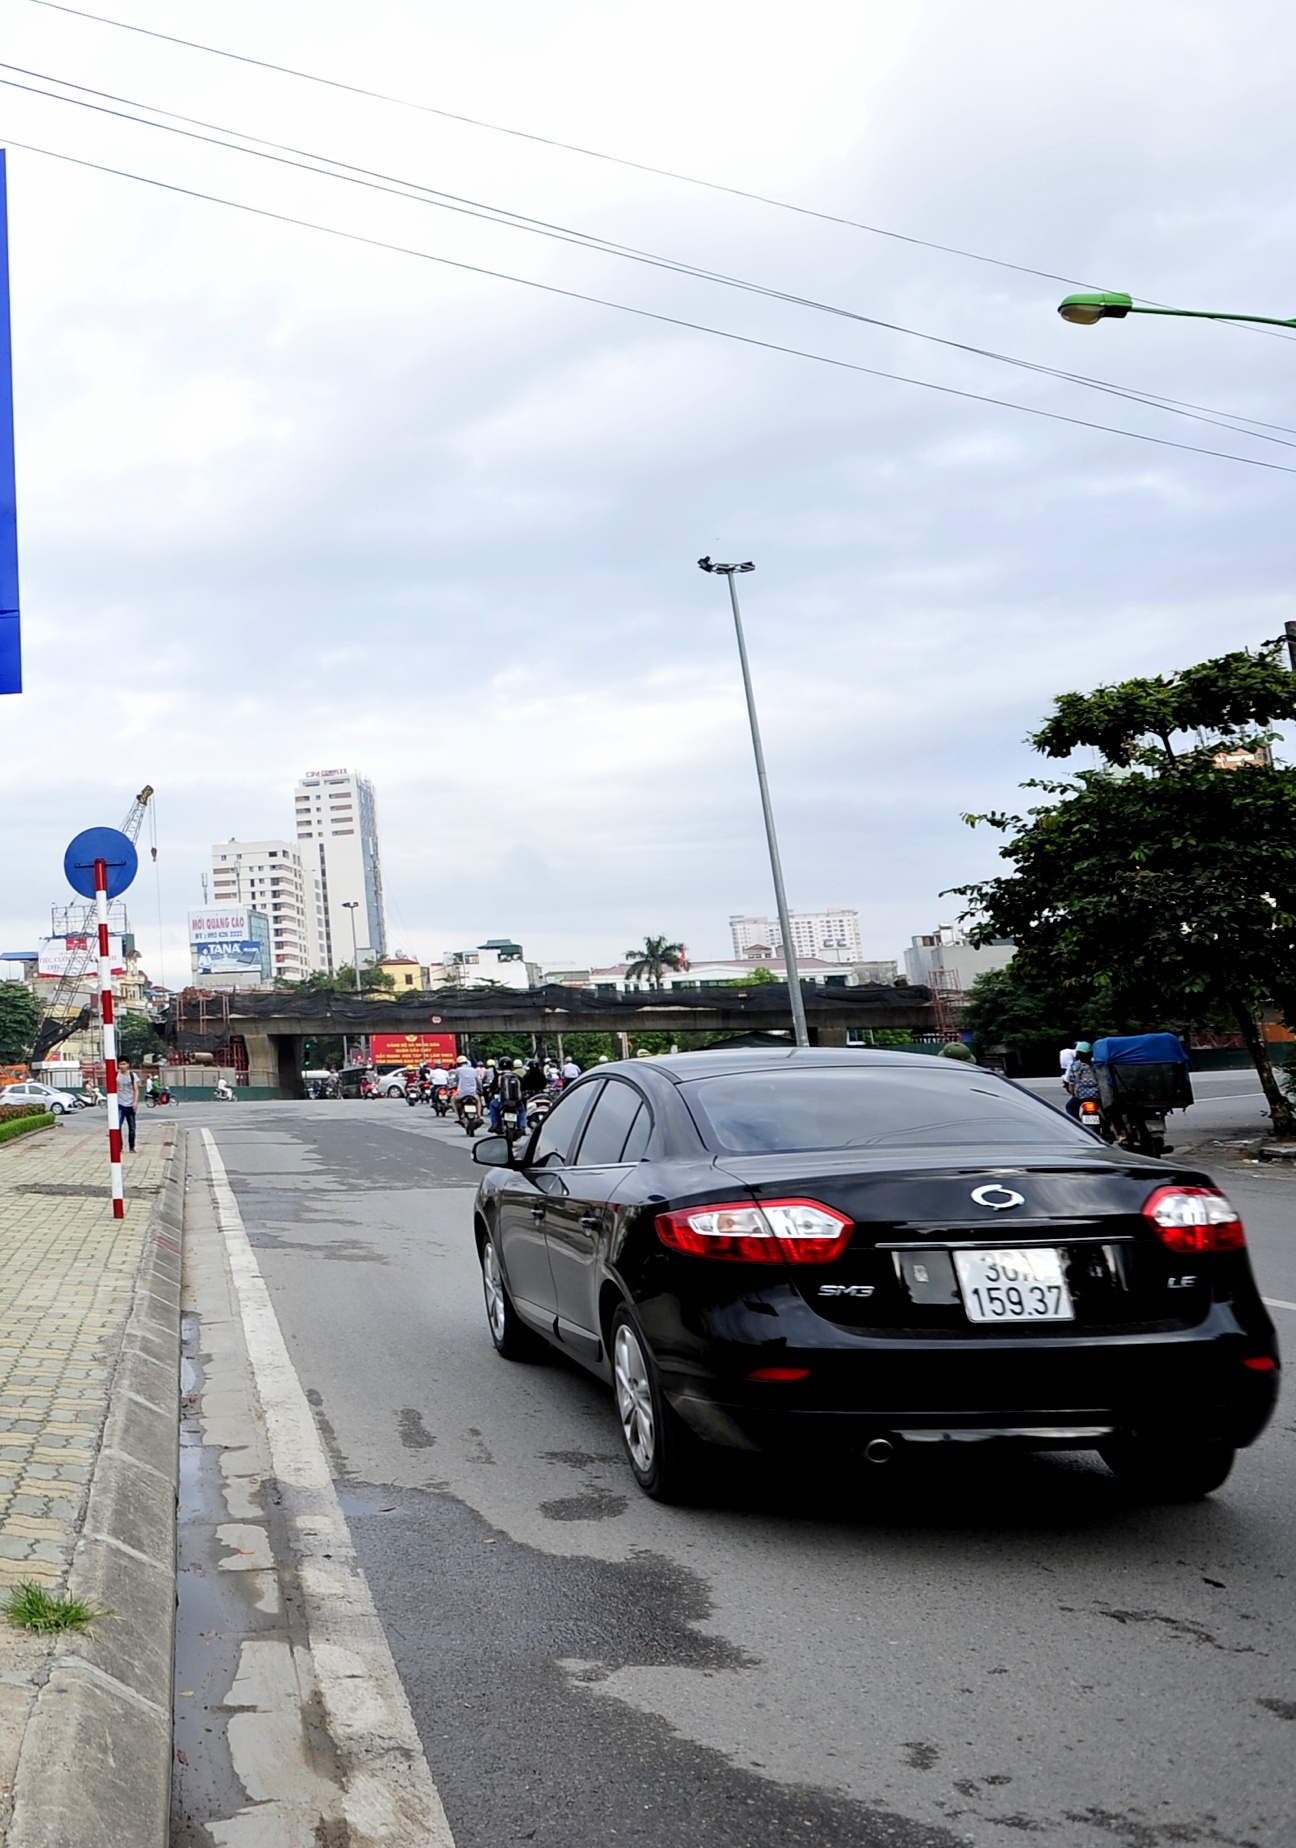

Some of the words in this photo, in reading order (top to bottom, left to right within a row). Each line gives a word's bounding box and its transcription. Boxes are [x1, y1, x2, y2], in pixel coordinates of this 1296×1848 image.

[206, 912, 230, 930] QUẢNG
[231, 912, 245, 928] CÁO
[207, 943, 242, 955] TANA
[1167, 1275, 1198, 1289] LE
[817, 1284, 875, 1297] SM3
[972, 1286, 1062, 1317] 159.37
